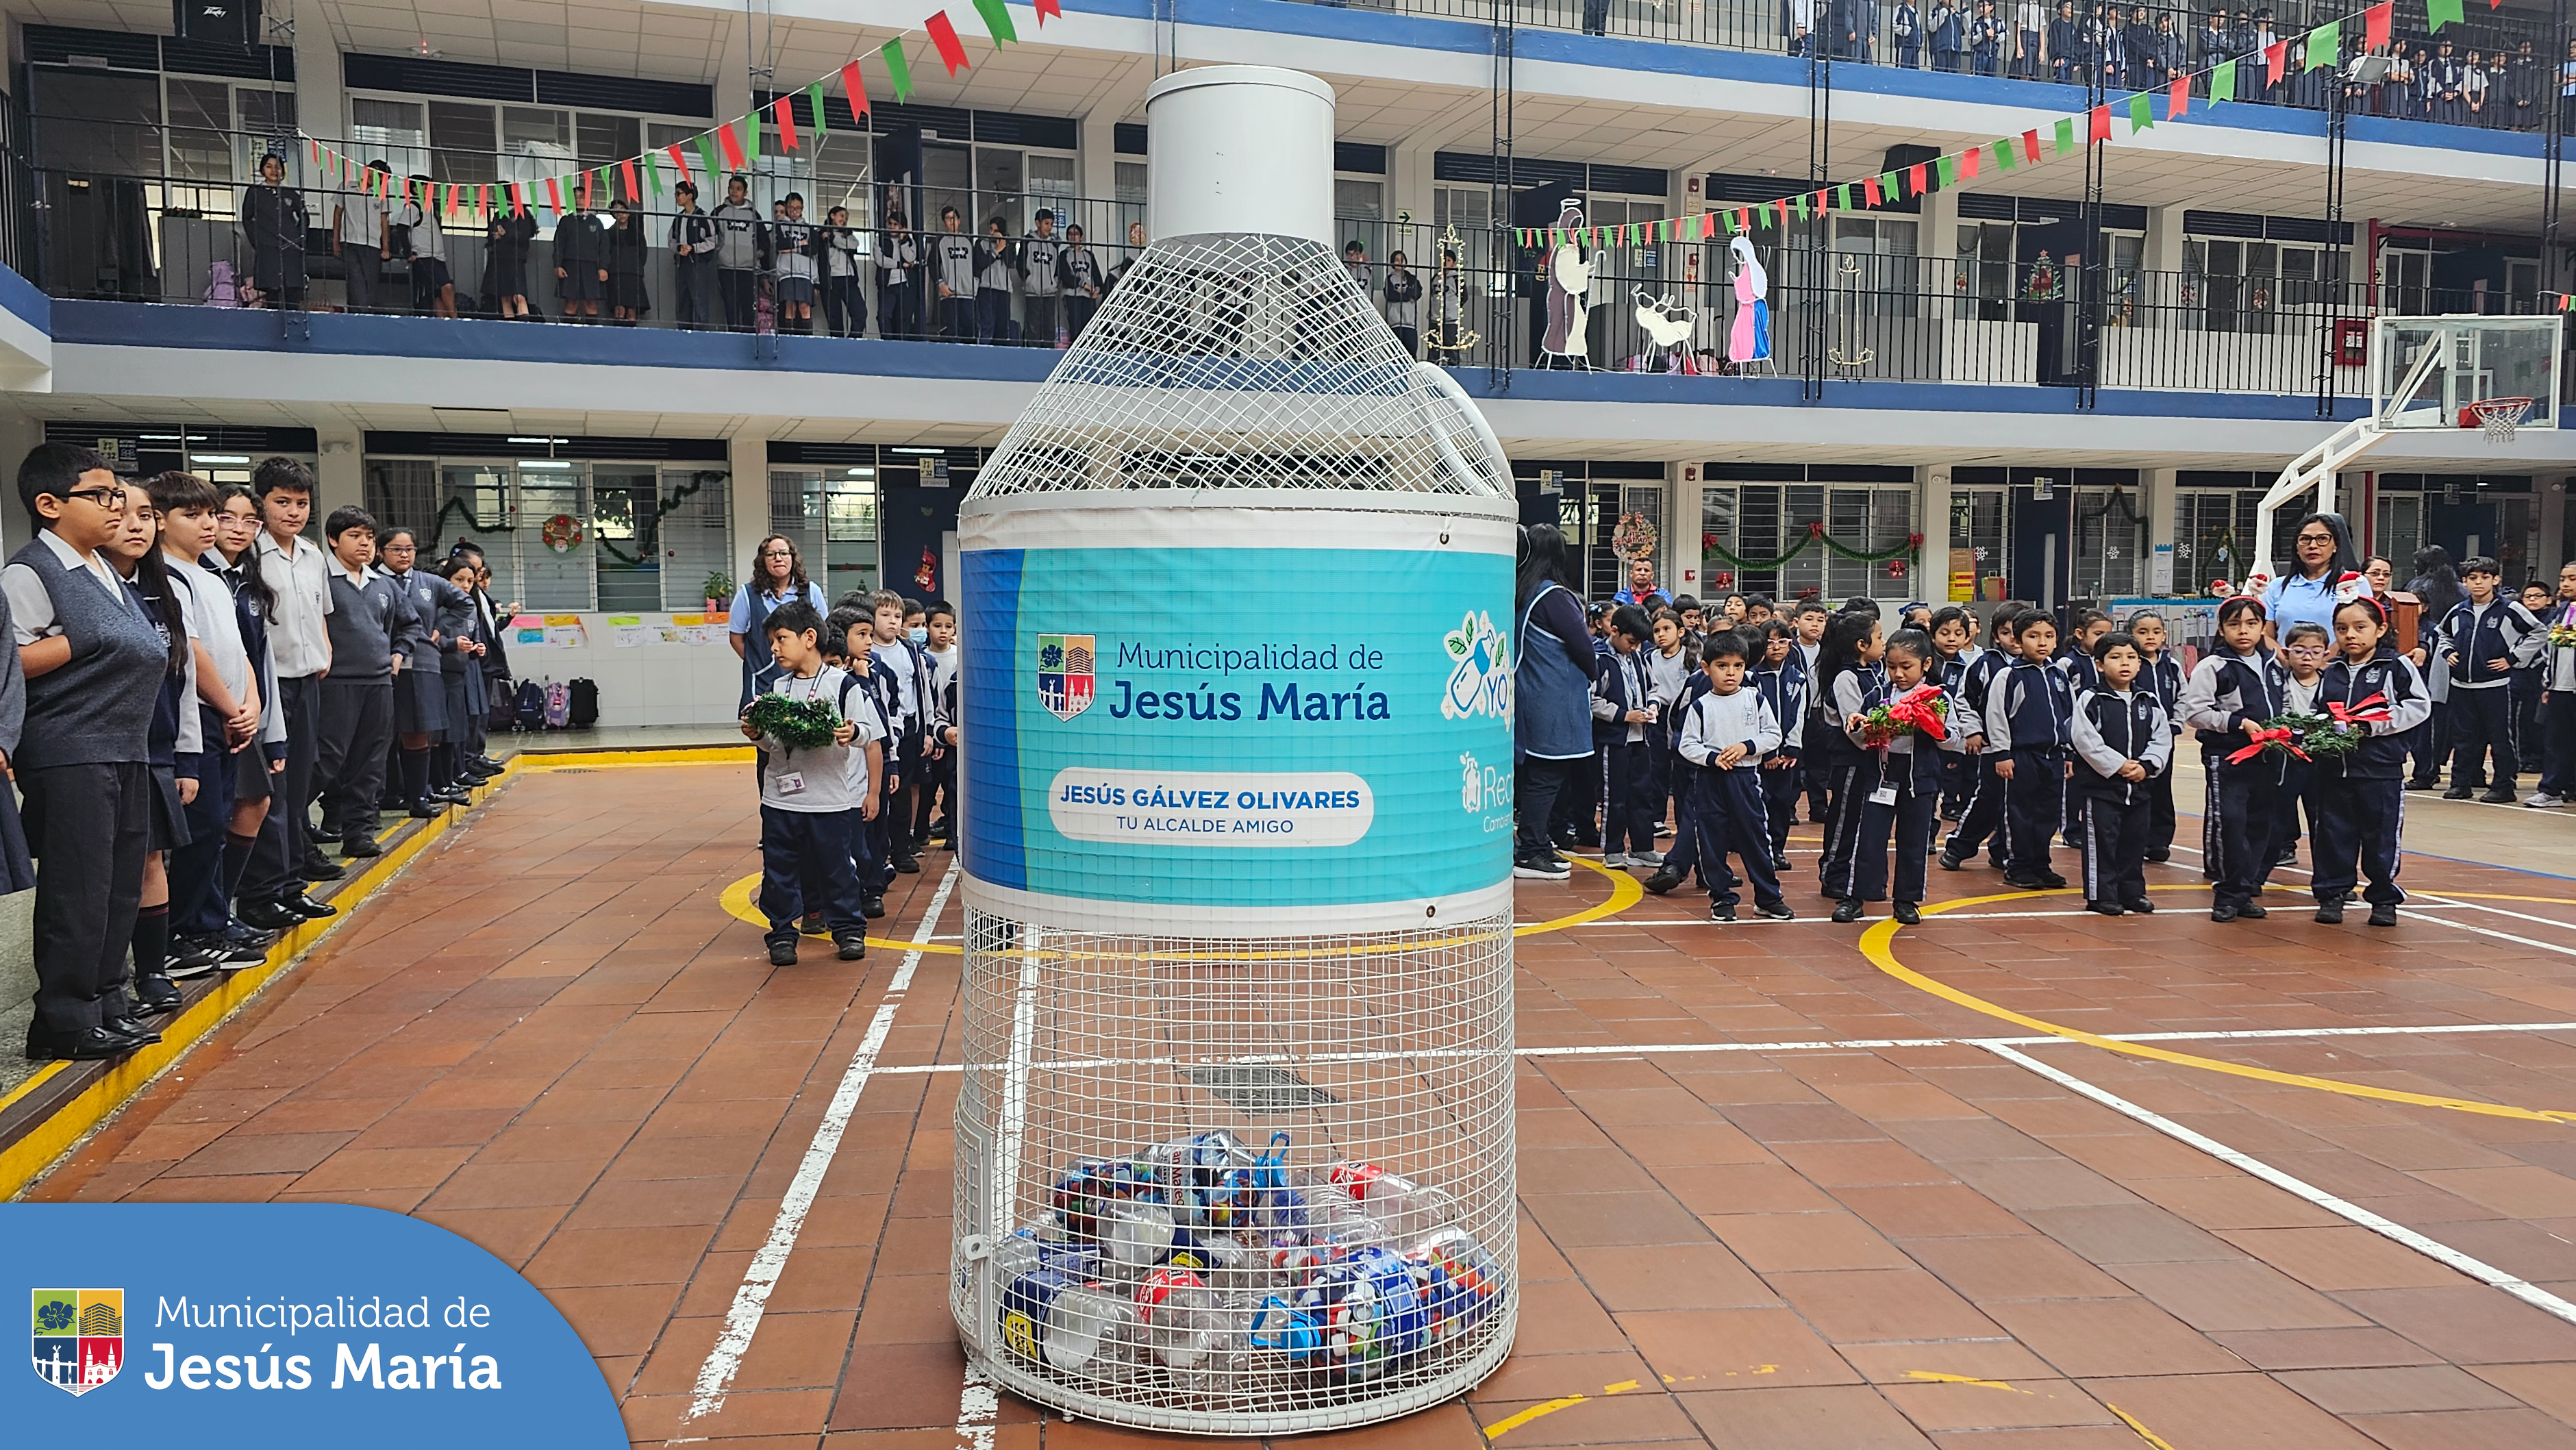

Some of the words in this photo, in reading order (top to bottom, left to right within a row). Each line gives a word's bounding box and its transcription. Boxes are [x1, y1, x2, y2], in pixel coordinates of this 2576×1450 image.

[1118, 642, 1338, 677] Municipalidad
[1349, 643, 1383, 670] de
[1110, 680, 1242, 721] Jesús
[1258, 682, 1390, 721] María
[1060, 782, 1126, 806] JESÚS
[1132, 784, 1229, 809] GÁLVEZ
[1237, 790, 1360, 810] OLIVARES
[1116, 816, 1138, 830] TU
[1143, 817, 1226, 833] ALCALDE
[1231, 820, 1294, 834] AMIGO
